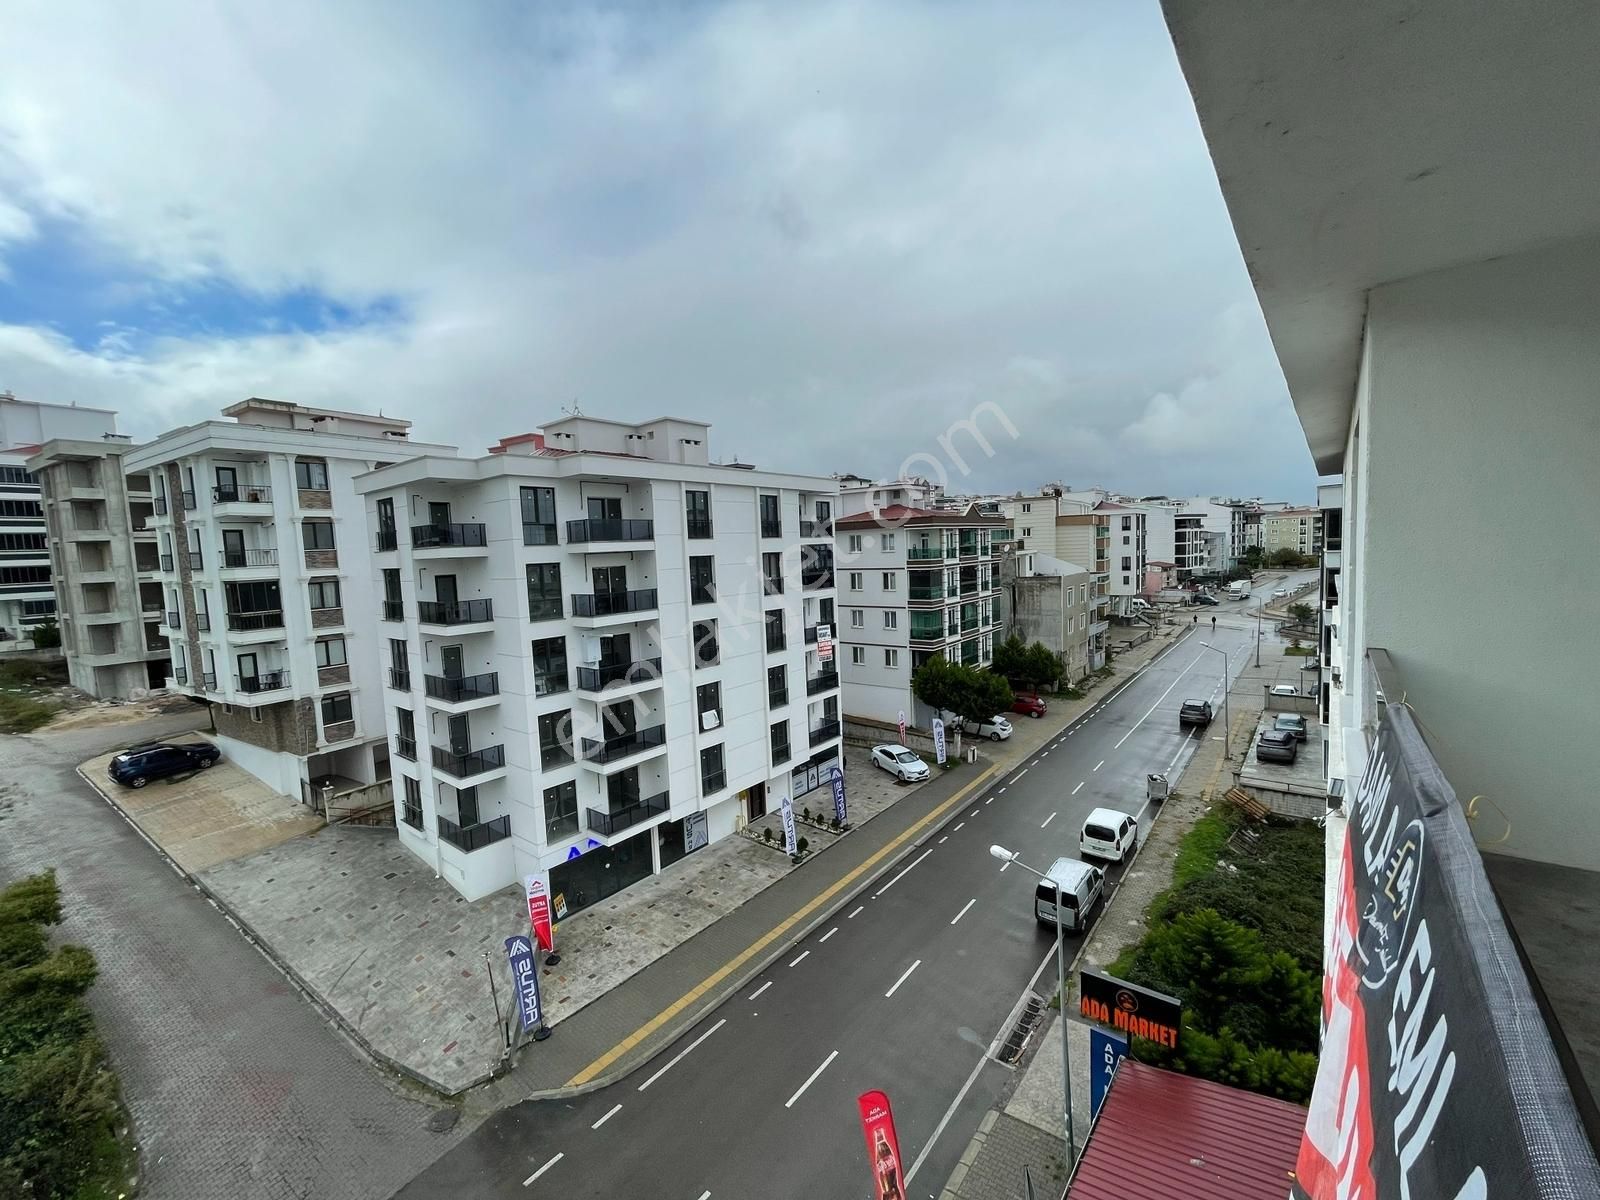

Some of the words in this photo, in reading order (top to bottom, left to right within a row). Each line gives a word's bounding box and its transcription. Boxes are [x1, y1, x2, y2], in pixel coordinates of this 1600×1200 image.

[1081, 994, 1110, 1023] ADA
[1114, 1007, 1178, 1049] MARKET
[1104, 1042, 1114, 1075] ADA
